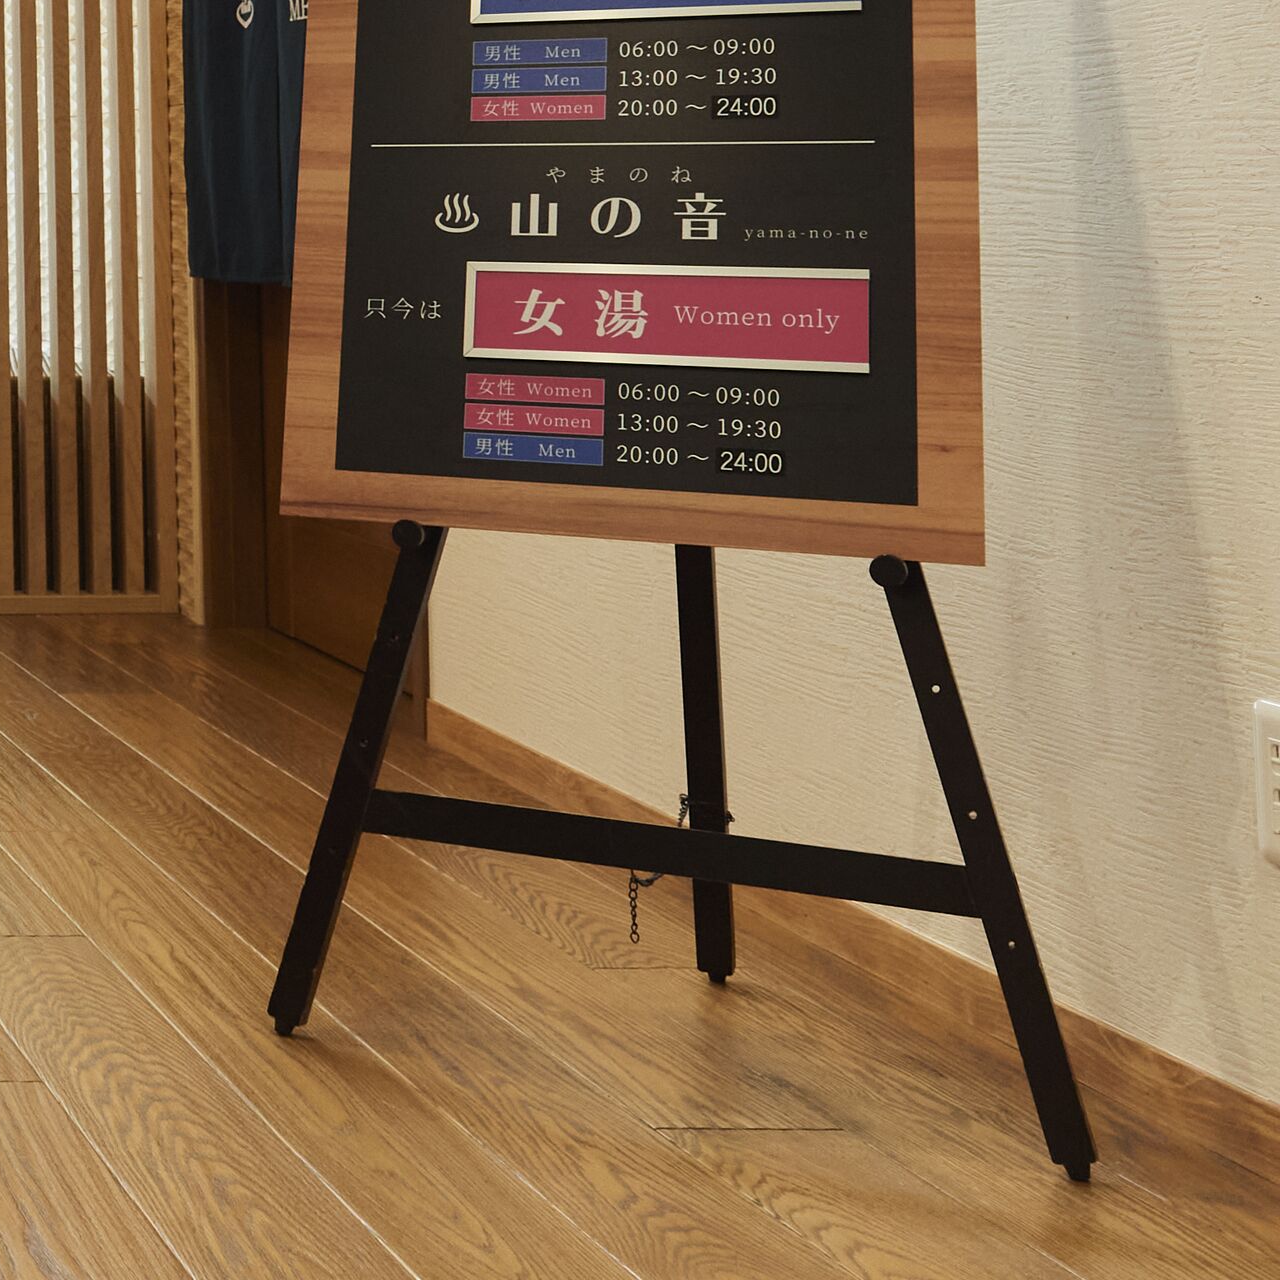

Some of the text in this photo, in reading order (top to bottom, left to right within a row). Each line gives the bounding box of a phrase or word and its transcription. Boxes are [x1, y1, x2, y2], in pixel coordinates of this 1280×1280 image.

[483, 44, 522, 62] 男性
[544, 44, 581, 59] Men
[618, 40, 679, 59] 06:00
[712, 38, 776, 57] 09:00
[482, 71, 521, 90] 男性
[544, 72, 581, 87] Men
[618, 69, 678, 88] 13:00
[715, 67, 777, 86] 19:30
[482, 99, 519, 117] 女性
[529, 100, 594, 115] Women
[617, 98, 678, 117] 20:00
[716, 96, 777, 117] 24:00
[546, 165, 693, 184] やまのね
[510, 192, 869, 241] 山の音 yama-no-ne
[364, 288, 840, 339] 只今は 女湯 Women only
[478, 378, 516, 397] 女性
[526, 382, 593, 399] Women
[617, 382, 680, 402] 06:00
[715, 386, 780, 407] 09:00
[476, 408, 515, 427] 女性
[526, 412, 592, 429] Women
[617, 413, 679, 433] 13:00
[717, 417, 782, 439] 19:30
[475, 438, 514, 457] 男性
[538, 444, 576, 459] Men
[616, 445, 679, 466] 20:00
[719, 450, 782, 474] 24:00
